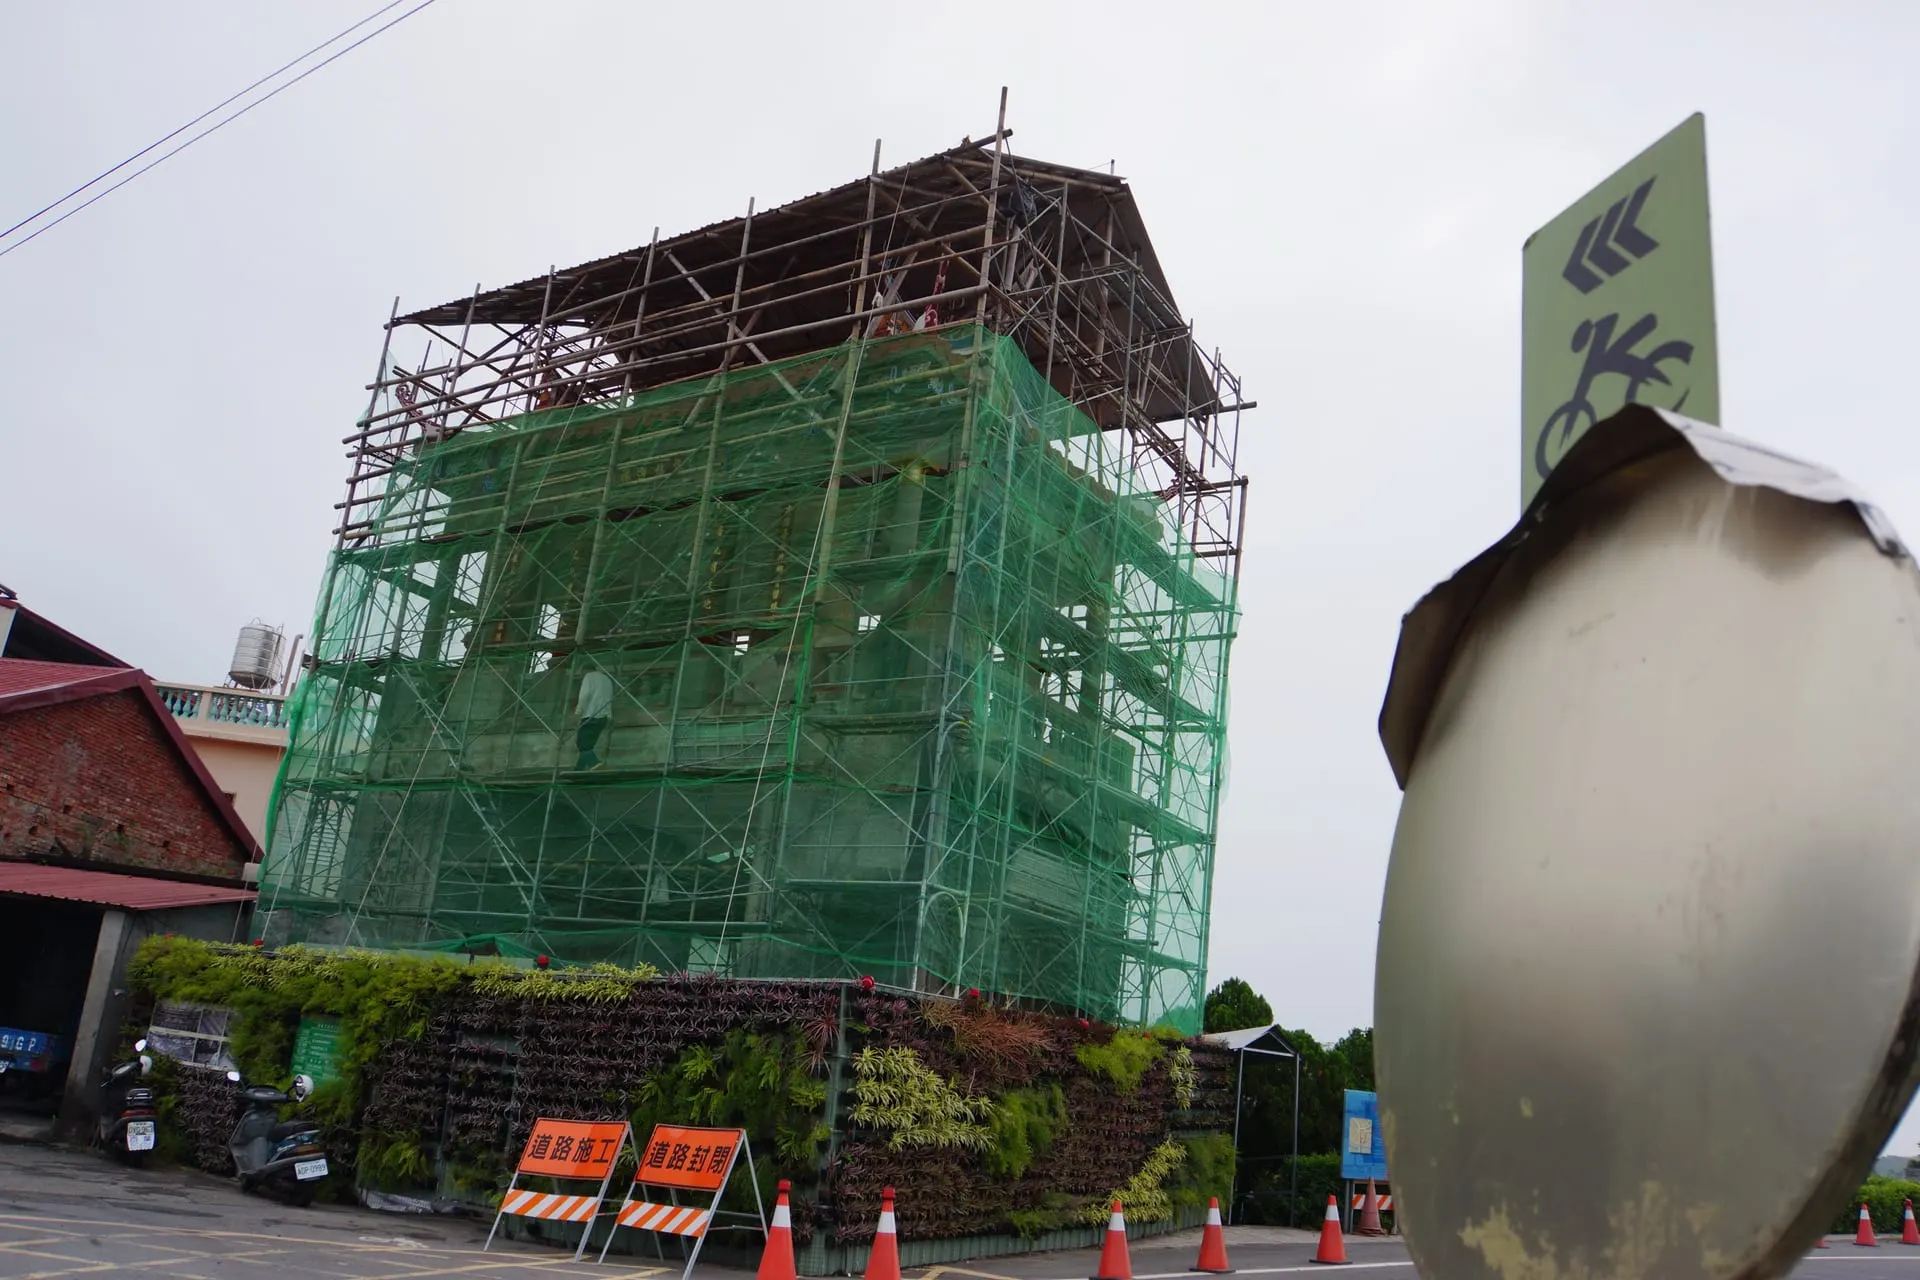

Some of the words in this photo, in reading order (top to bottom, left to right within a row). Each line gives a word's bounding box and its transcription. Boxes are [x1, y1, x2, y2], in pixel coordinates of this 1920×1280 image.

[527, 1134, 616, 1164] 道路施工
[646, 1142, 731, 1174] 道路封閉
